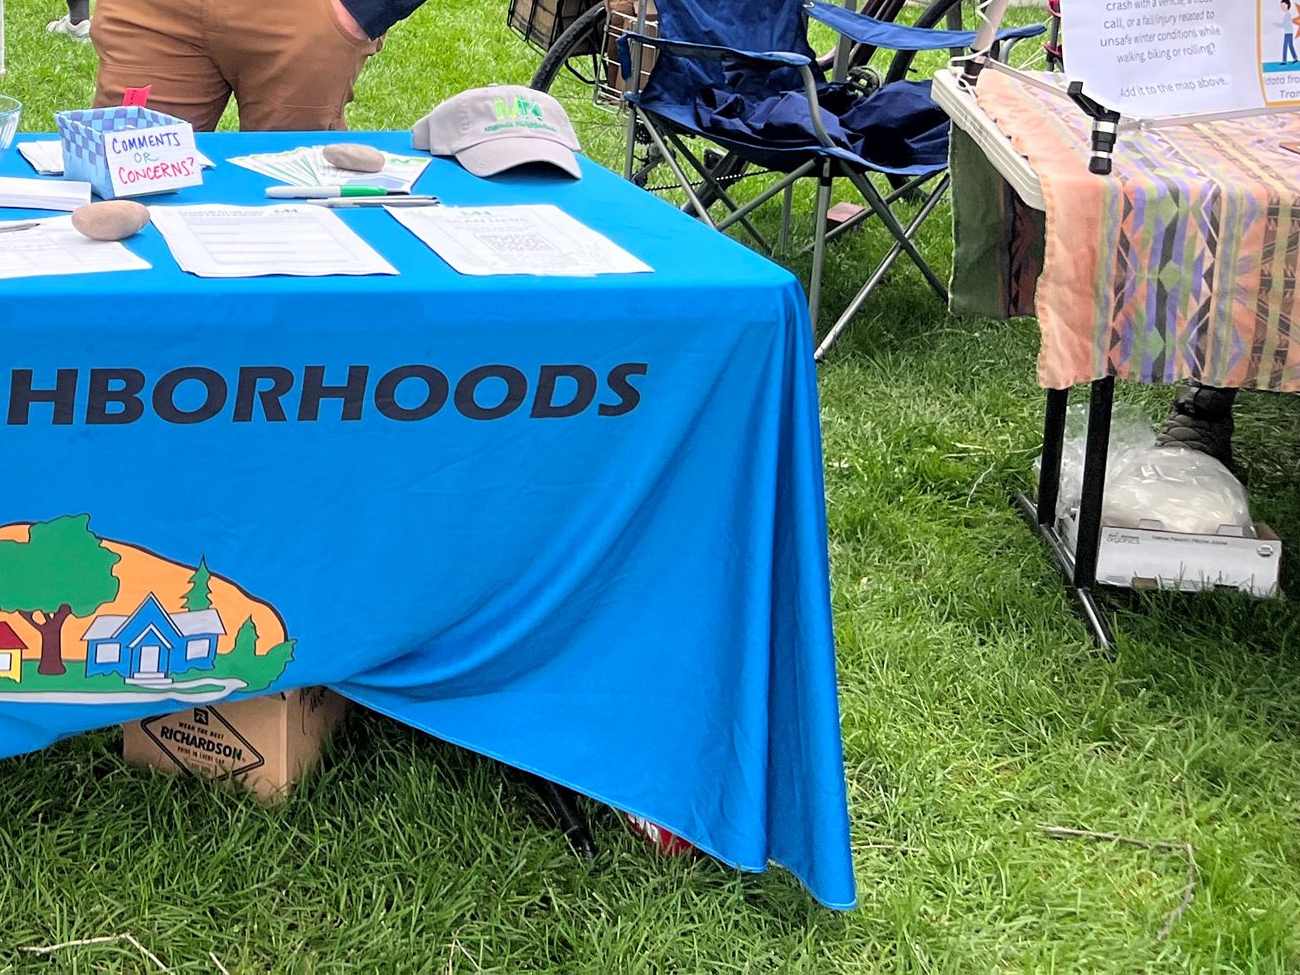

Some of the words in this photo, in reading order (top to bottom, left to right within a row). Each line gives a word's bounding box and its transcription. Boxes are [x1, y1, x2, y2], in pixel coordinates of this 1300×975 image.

[1106, 0, 1133, 11] crash
[1103, 17, 1125, 29] call,
[1126, 18, 1135, 27] or
[1179, 10, 1205, 22] related
[1206, 10, 1215, 20] to
[1100, 34, 1132, 47] unsafe
[1134, 32, 1156, 43] winter
[1157, 28, 1197, 41] conditions
[1199, 25, 1220, 37] while
[1147, 48, 1172, 61] biking
[1172, 48, 1182, 57] or
[1183, 42, 1215, 56] rolling?
[1119, 87, 1136, 97] Add
[1146, 85, 1157, 95] to
[1157, 82, 1174, 93] the
[1175, 80, 1196, 91] map
[112, 132, 180, 155] COMMENTS
[134, 152, 160, 163] OR
[118, 157, 195, 185] CONCERNS?
[197, 727, 208, 736] THE
[160, 725, 242, 761] RICHARDSON
